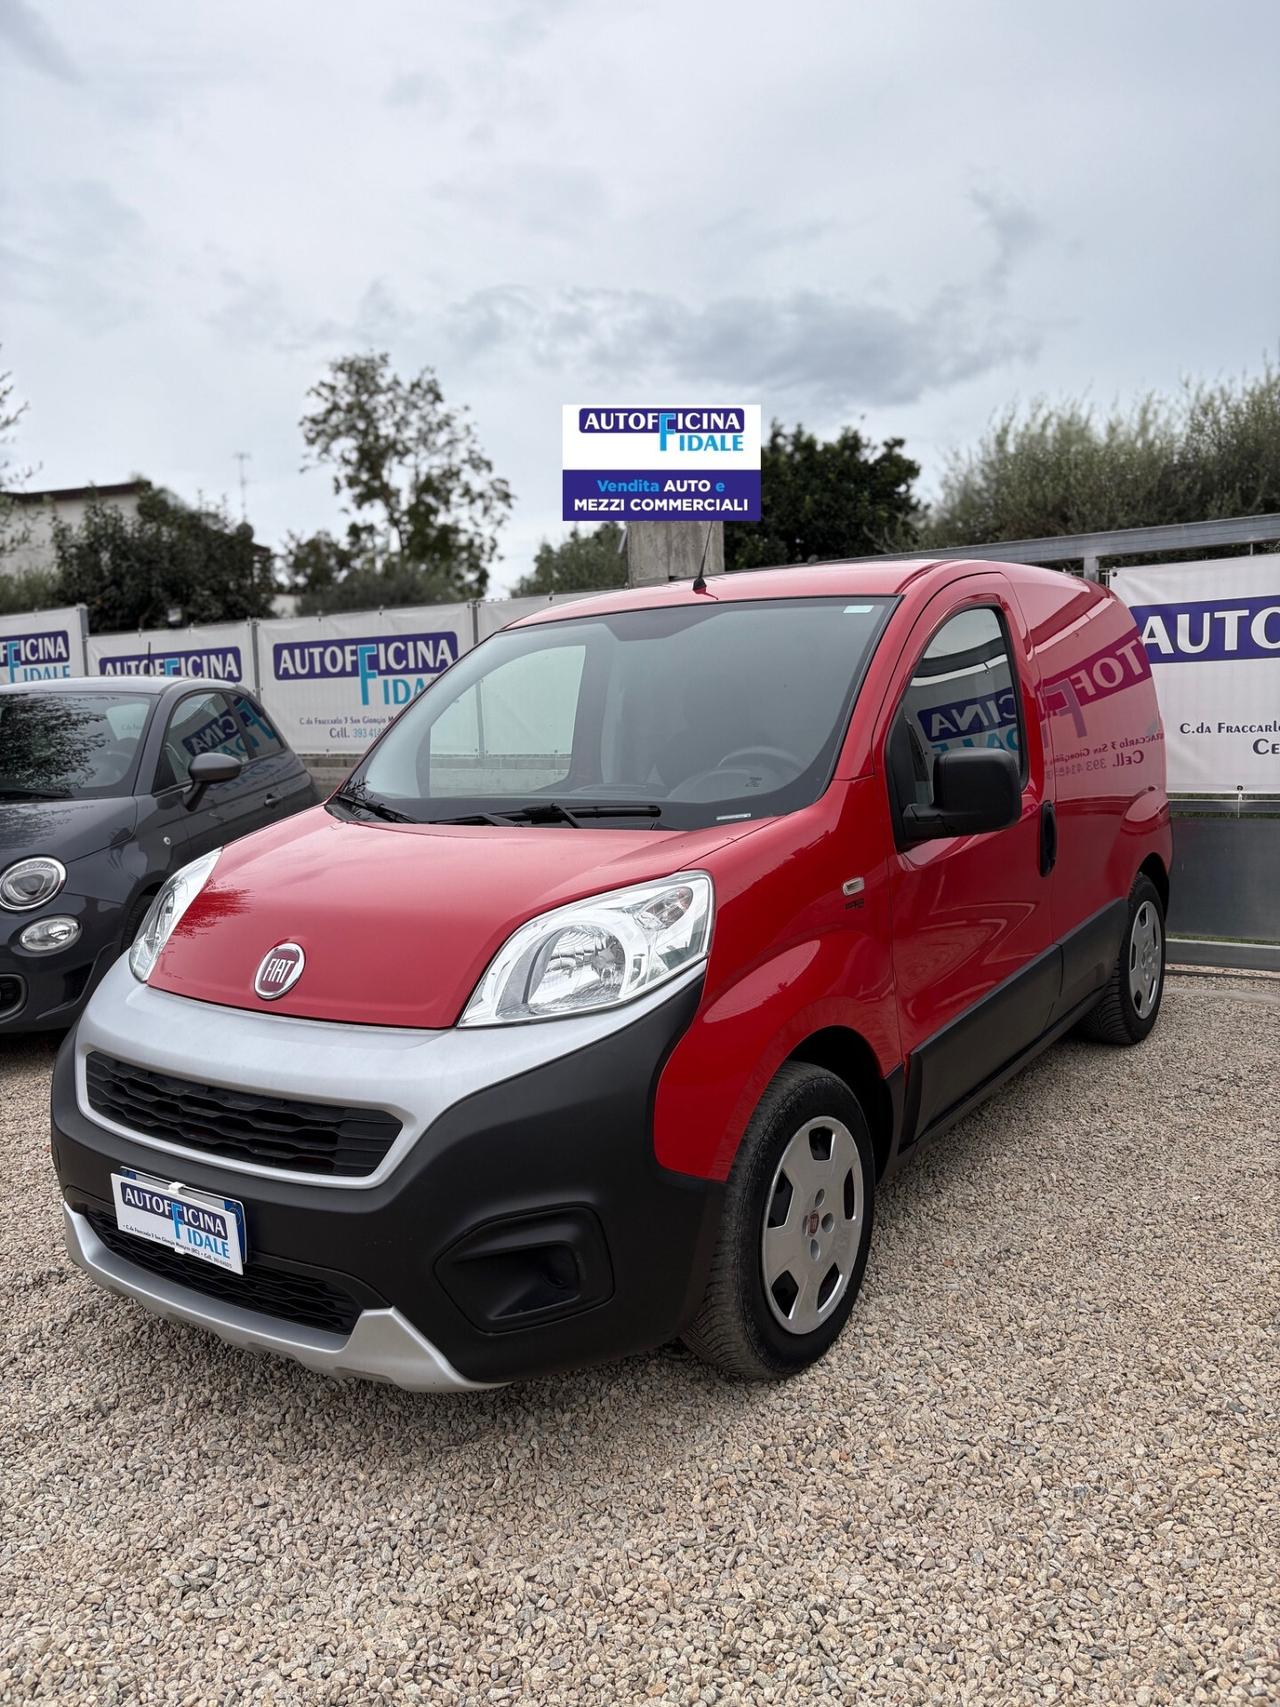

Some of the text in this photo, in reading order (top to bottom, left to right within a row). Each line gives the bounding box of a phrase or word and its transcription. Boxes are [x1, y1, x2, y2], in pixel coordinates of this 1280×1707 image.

[279, 639, 454, 675] AUTOFFICINA
[263, 958, 295, 983] FIAT
[125, 1188, 225, 1236] AUTOFFICINA
